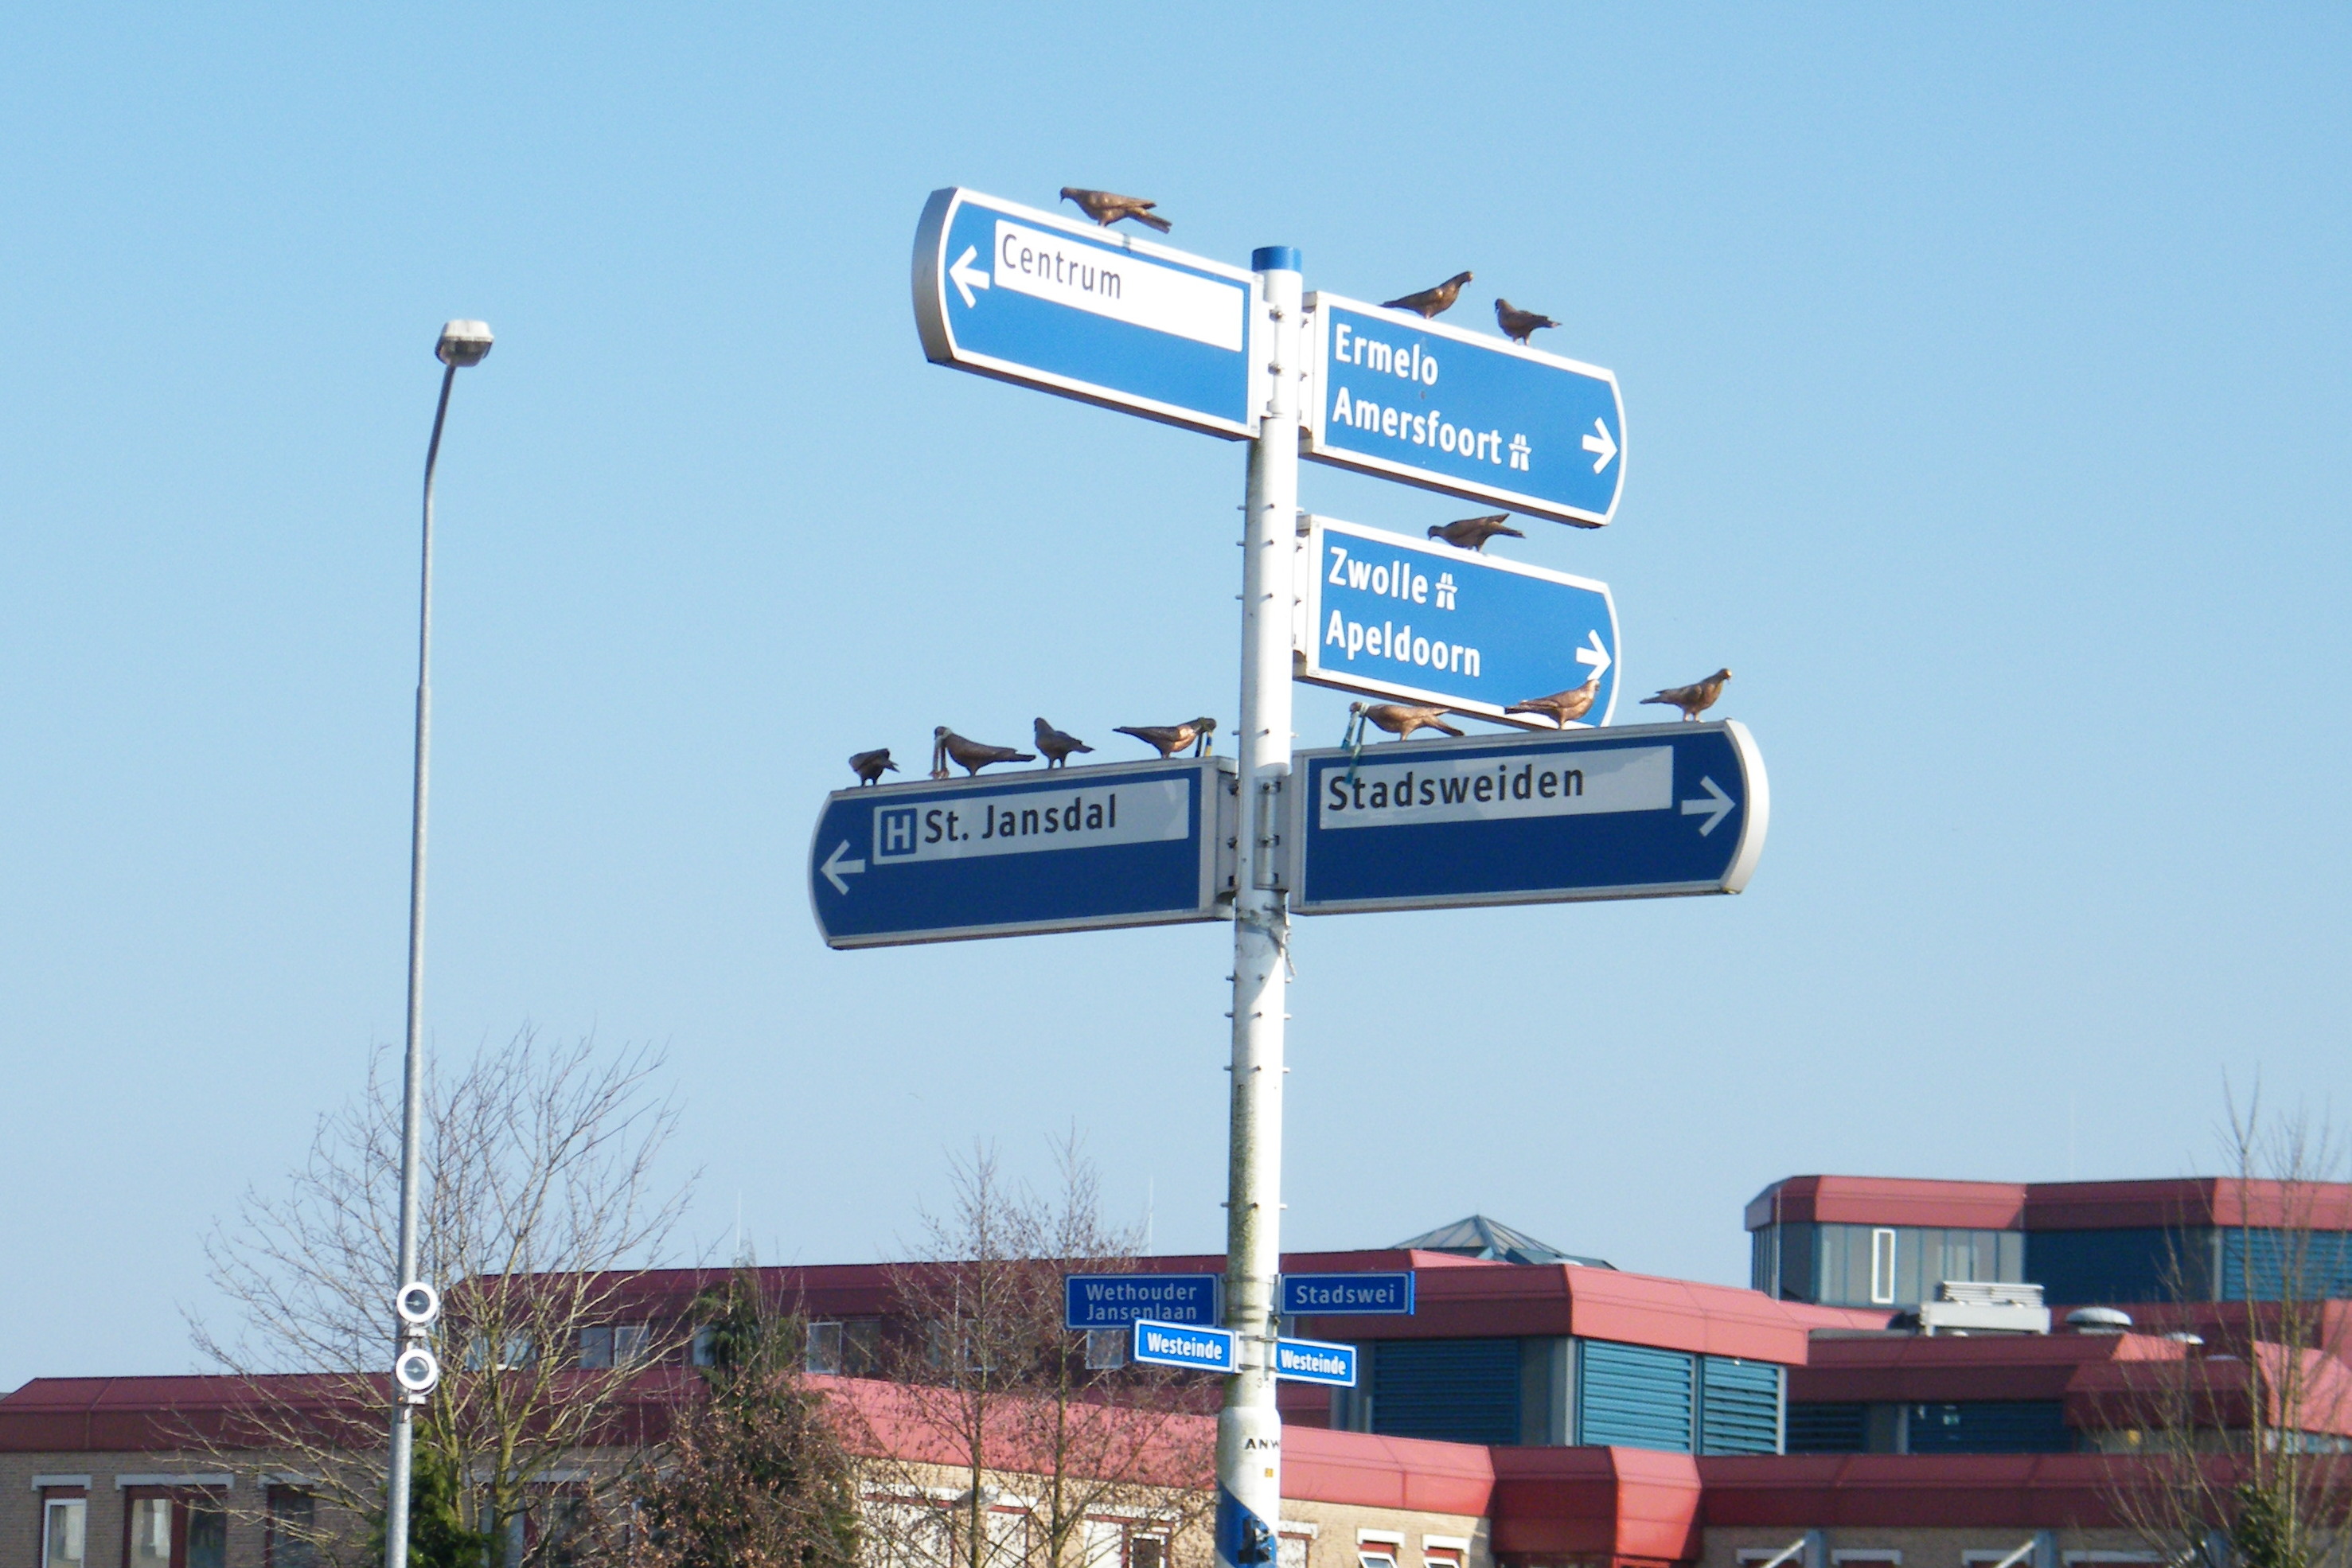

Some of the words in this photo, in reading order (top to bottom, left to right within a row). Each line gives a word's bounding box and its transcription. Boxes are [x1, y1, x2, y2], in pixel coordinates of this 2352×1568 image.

[1002, 233, 1121, 299] Centrum
[1335, 322, 1439, 385] Ermelo
[1332, 386, 1503, 465] Amersfoort
[1328, 546, 1429, 604] Zwolle
[1325, 609, 1480, 677] Apeldoorn
[1328, 763, 1584, 811] Stadsweiden
[886, 813, 911, 851] H
[924, 809, 969, 844] St.
[981, 793, 1116, 839] Jansdal
[1085, 1282, 1198, 1301] Wethouder
[1086, 1302, 1197, 1321] Jansenlaan
[1296, 1284, 1394, 1305] Stadswei
[1147, 1332, 1223, 1361] Westeinde
[1281, 1348, 1347, 1376] Westeinde
